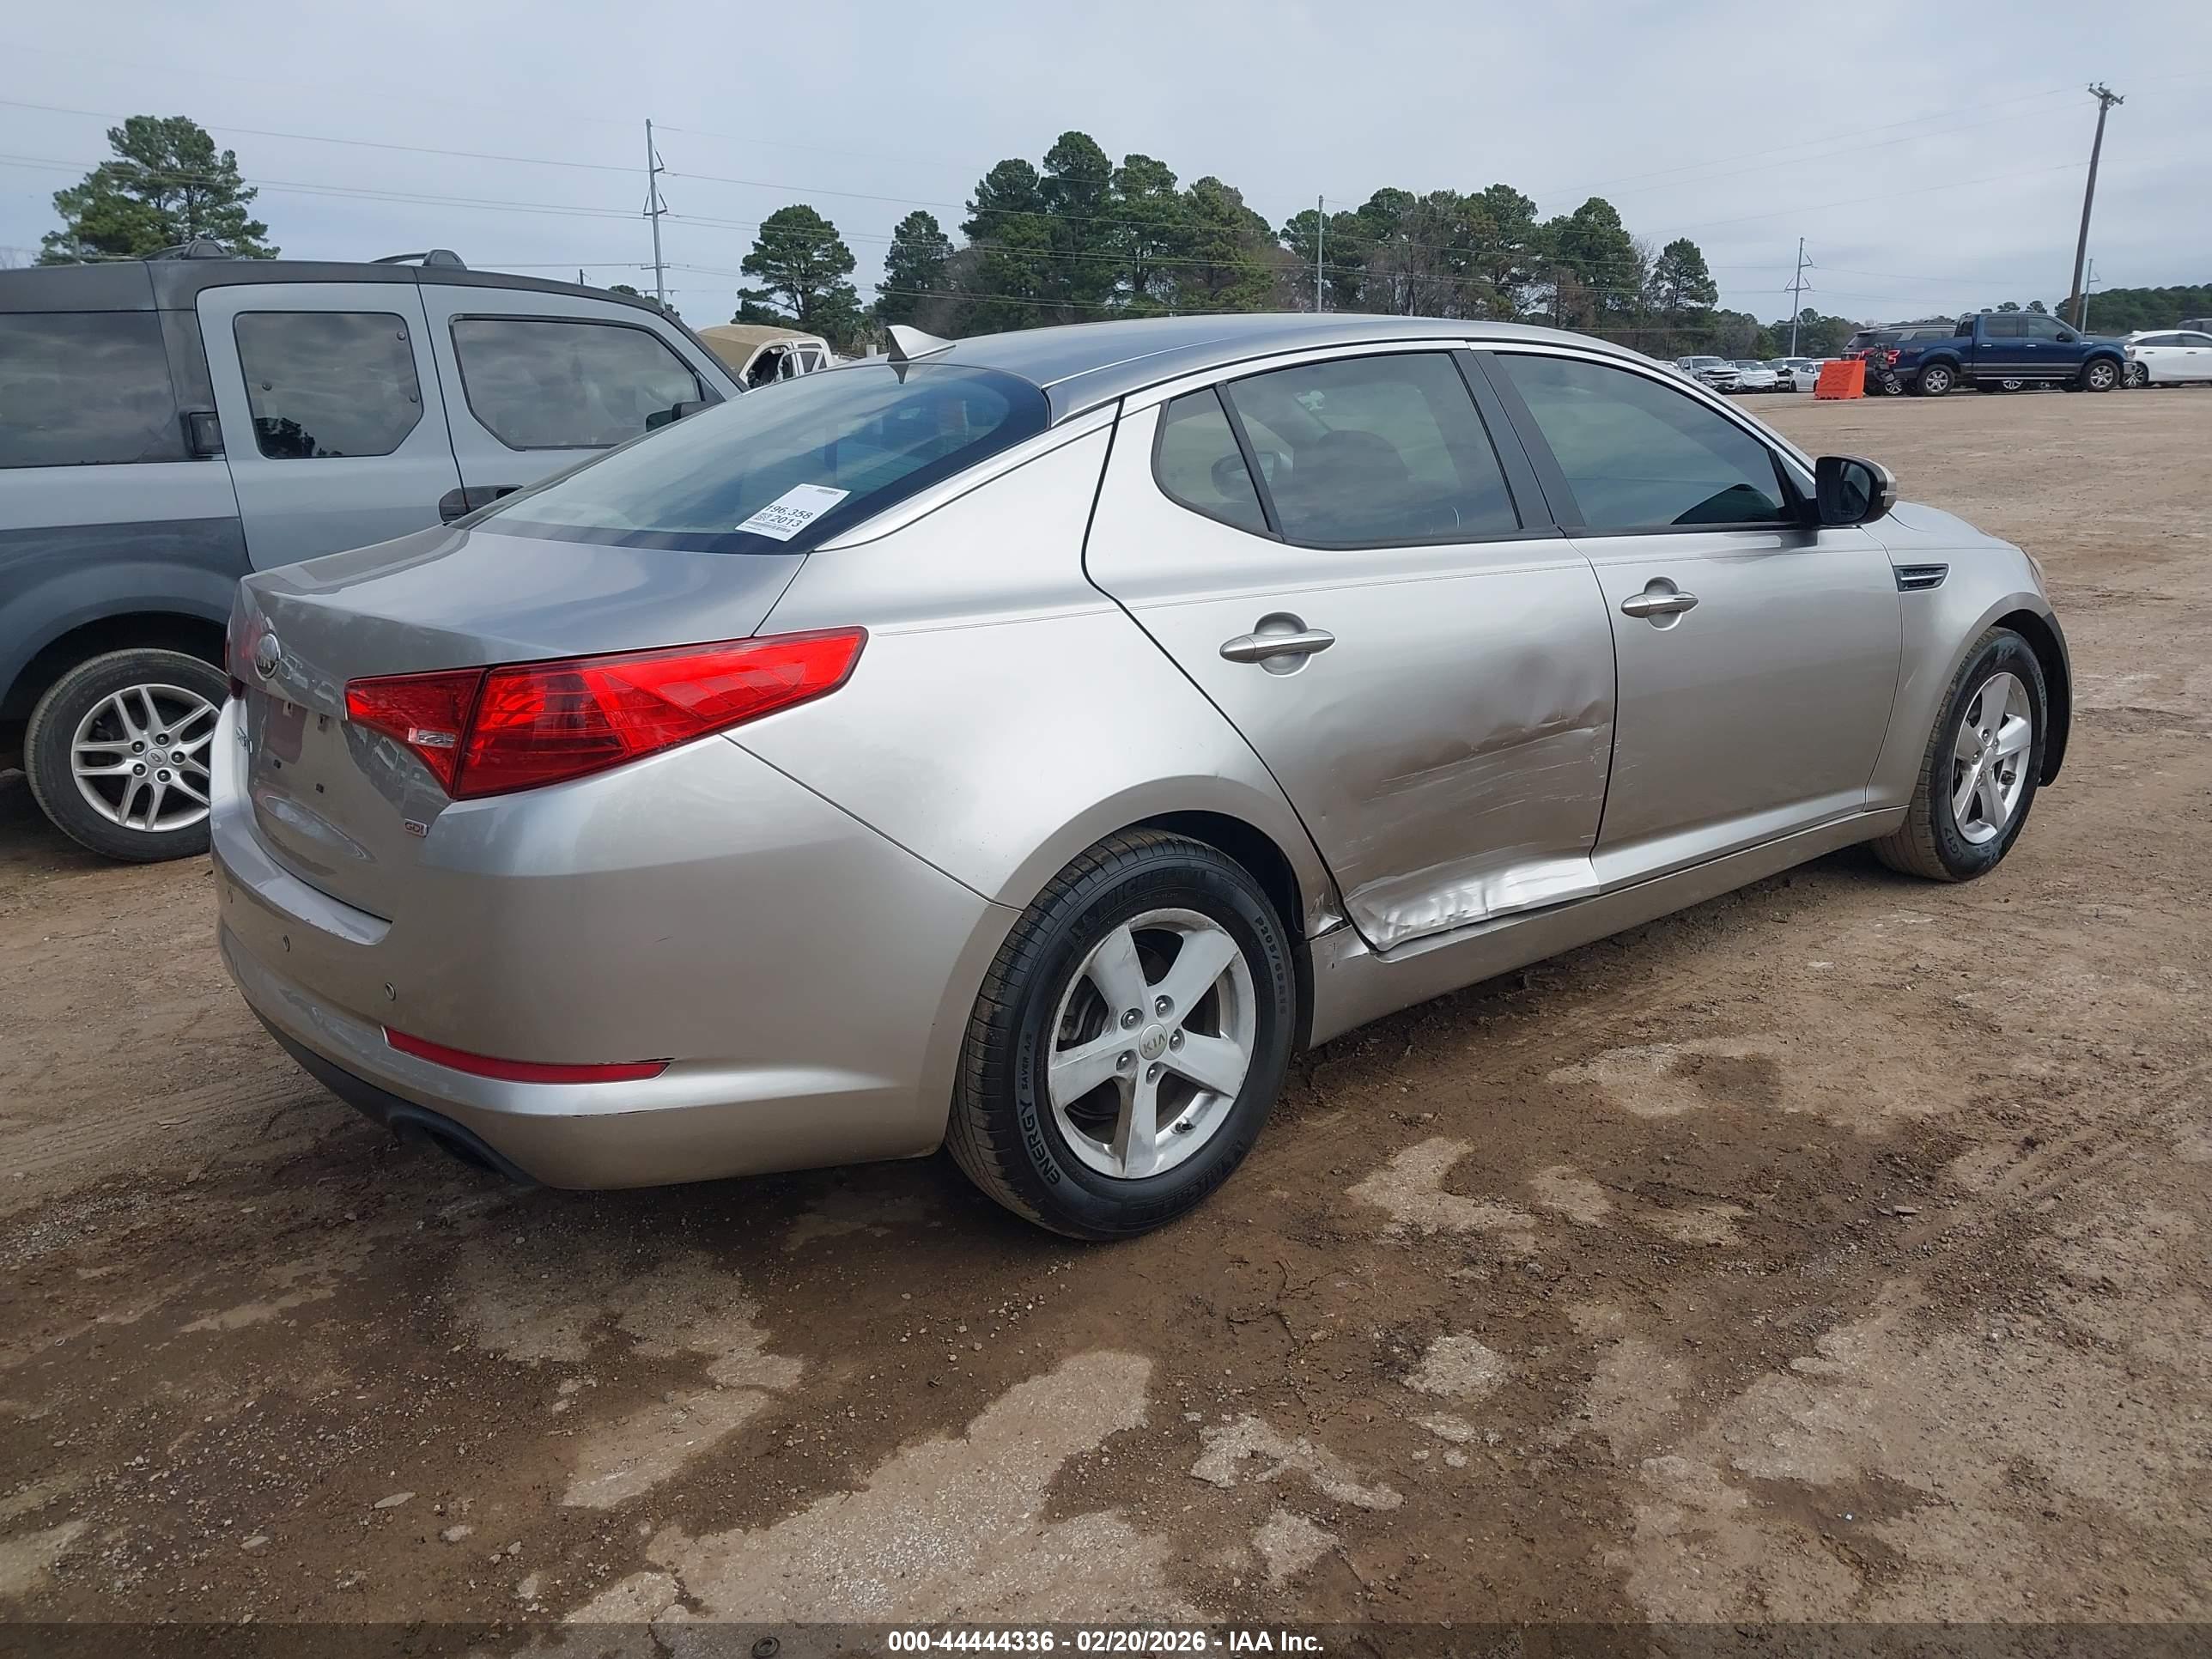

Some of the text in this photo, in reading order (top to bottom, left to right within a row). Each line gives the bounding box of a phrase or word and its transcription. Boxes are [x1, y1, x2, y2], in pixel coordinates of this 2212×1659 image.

[764, 504, 814, 520] 196,358
[769, 515, 803, 527] 2013
[1143, 1033, 1166, 1054] KIA
[1020, 1055, 1031, 1091] SAVER
[1019, 1098, 1061, 1185] ENERGY
